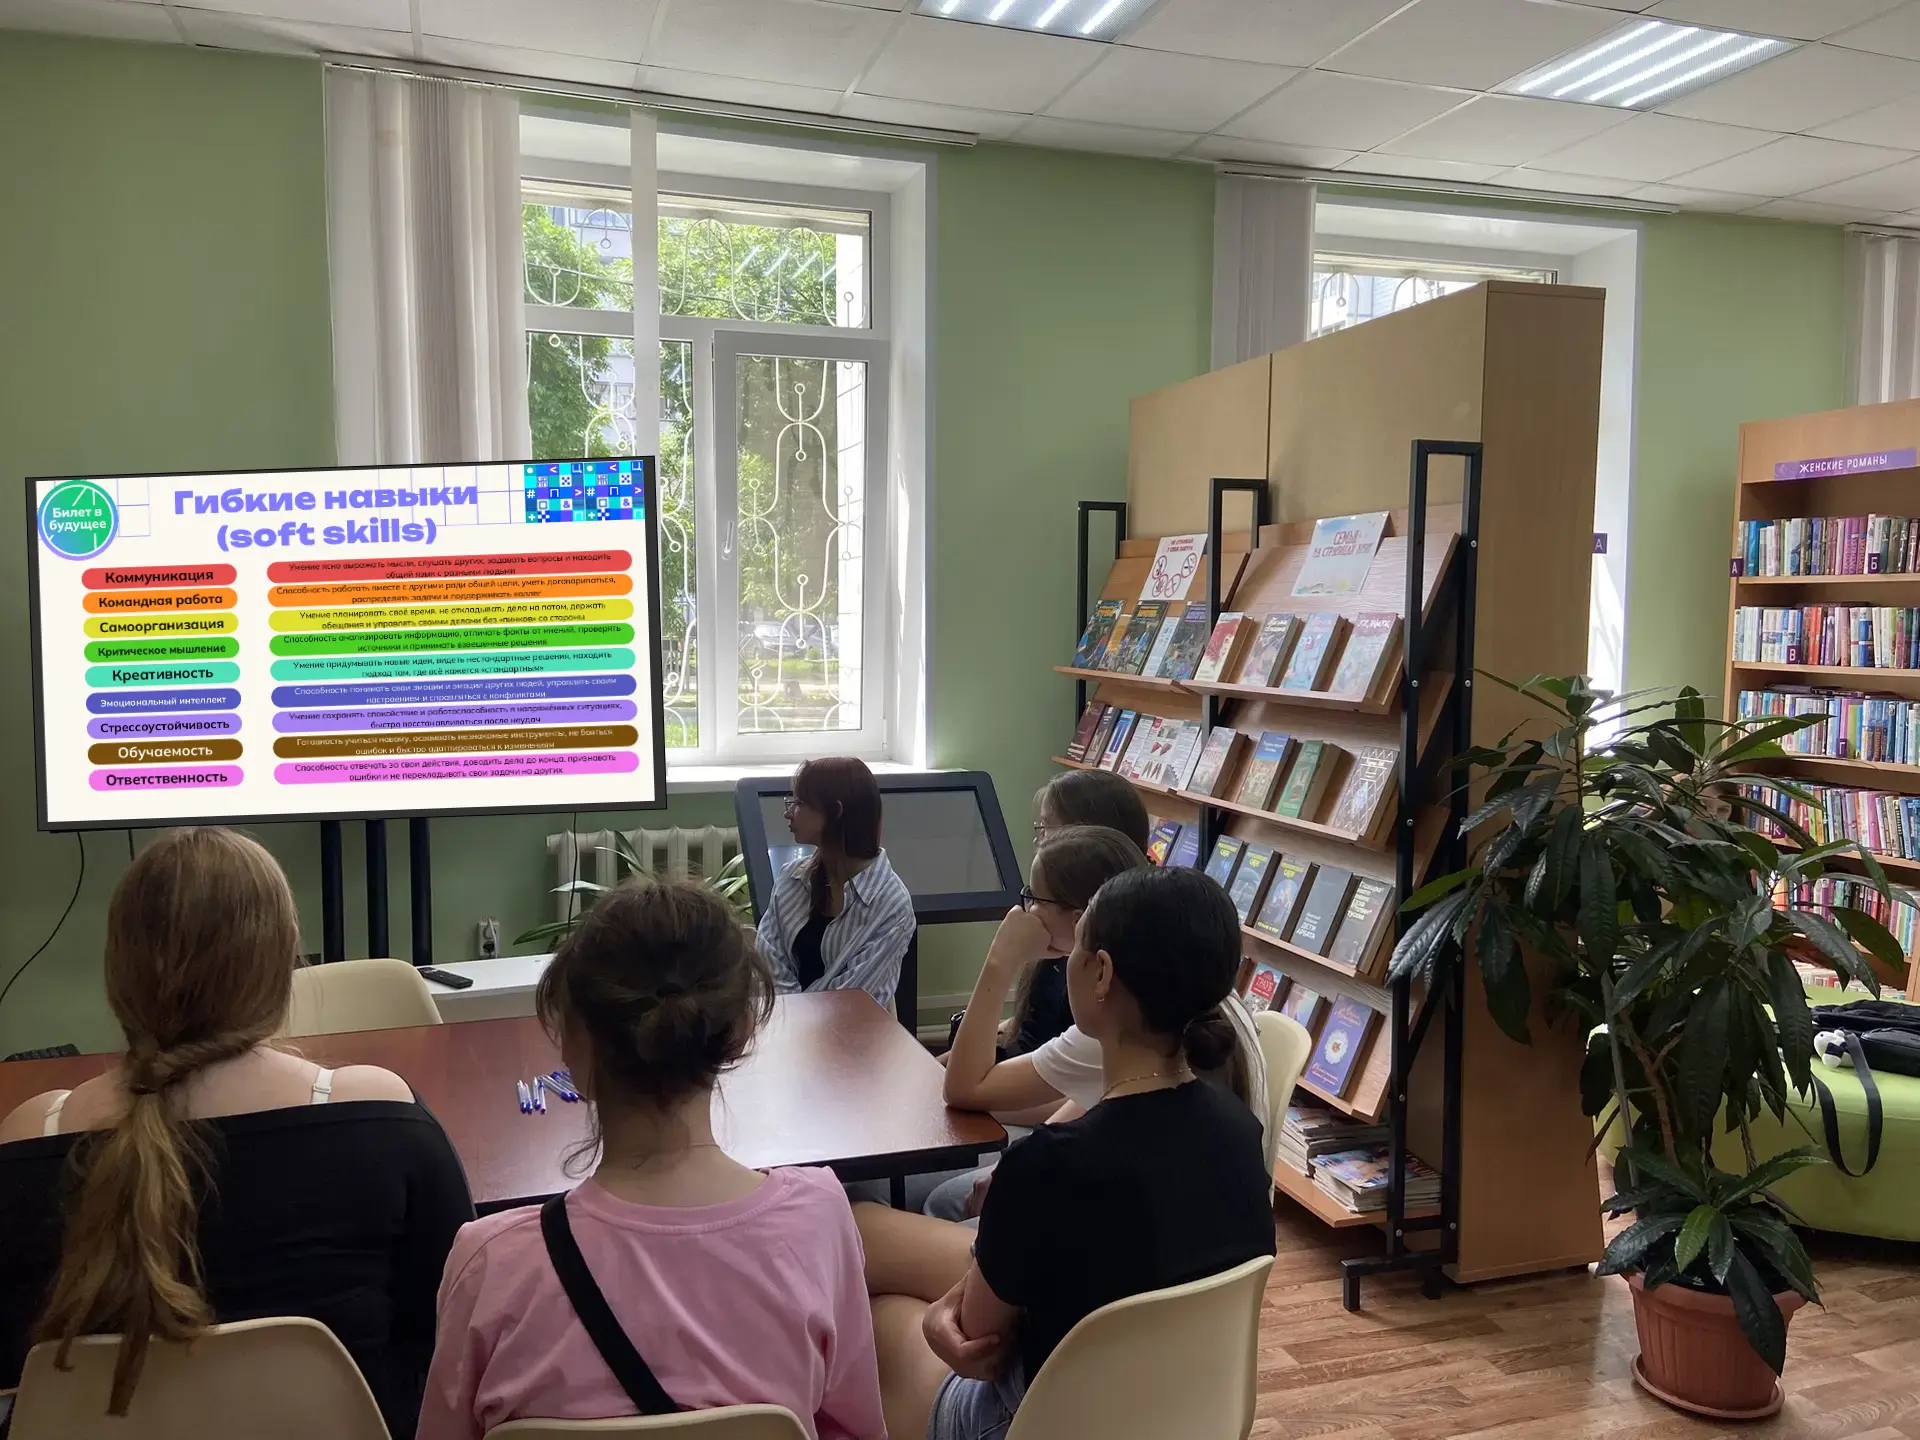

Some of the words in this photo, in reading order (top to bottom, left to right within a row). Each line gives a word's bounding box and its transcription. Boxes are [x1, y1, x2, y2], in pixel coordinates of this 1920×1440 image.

[1799, 460, 1843, 474] ЖЕНСКИЕ
[1846, 454, 1888, 469] РОМАНЫ
[174, 487, 316, 515] Гибкие
[324, 486, 478, 509] навыки
[52, 507, 92, 518] Билет
[94, 508, 102, 517] в
[49, 519, 107, 533] будущее
[217, 521, 315, 552] (soft
[323, 517, 437, 545] skills)
[1594, 538, 1603, 551] А
[1731, 561, 1738, 574] А
[1870, 556, 1878, 570] Б
[105, 571, 214, 585] Коммуникация
[98, 596, 172, 608] Командная
[175, 594, 223, 608] работа
[99, 620, 224, 635] Самоорганизация
[97, 646, 167, 659] Критическое
[169, 644, 226, 654] мышление
[1789, 648, 1796, 661] В
[112, 669, 214, 684] Креативность
[100, 696, 177, 708] Эмоциональный
[179, 696, 227, 705] интеллект
[100, 719, 230, 735] Стрессоустойчивость
[118, 746, 213, 761] Обучаемость
[1839, 741, 1846, 755] Г
[106, 773, 228, 786] Ответственность
